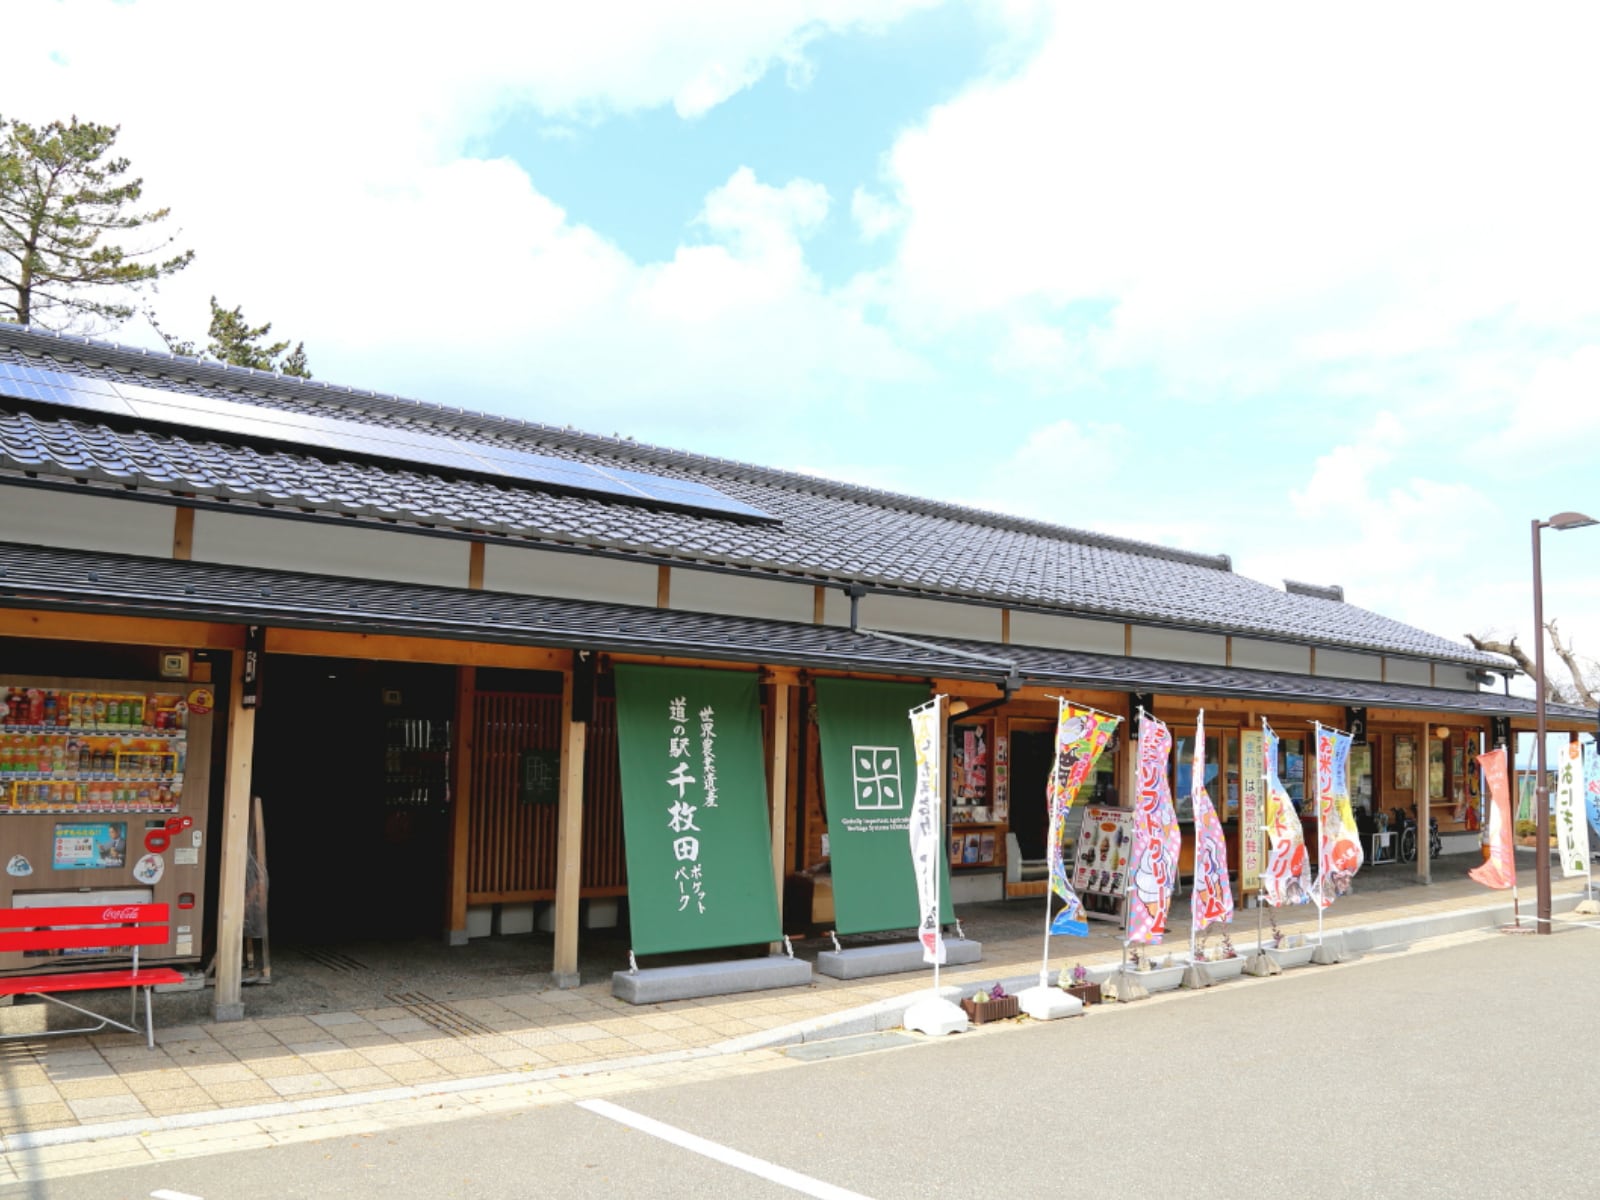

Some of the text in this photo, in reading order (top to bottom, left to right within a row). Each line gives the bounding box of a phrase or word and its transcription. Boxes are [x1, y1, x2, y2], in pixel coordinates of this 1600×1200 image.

[698, 705, 719, 808] 世界農業遺産
[1141, 766, 1168, 933] ソフトクリーム
[102, 907, 139, 920] Coca-Cola
[674, 866, 691, 912] パーク
[690, 864, 706, 914] ポケット
